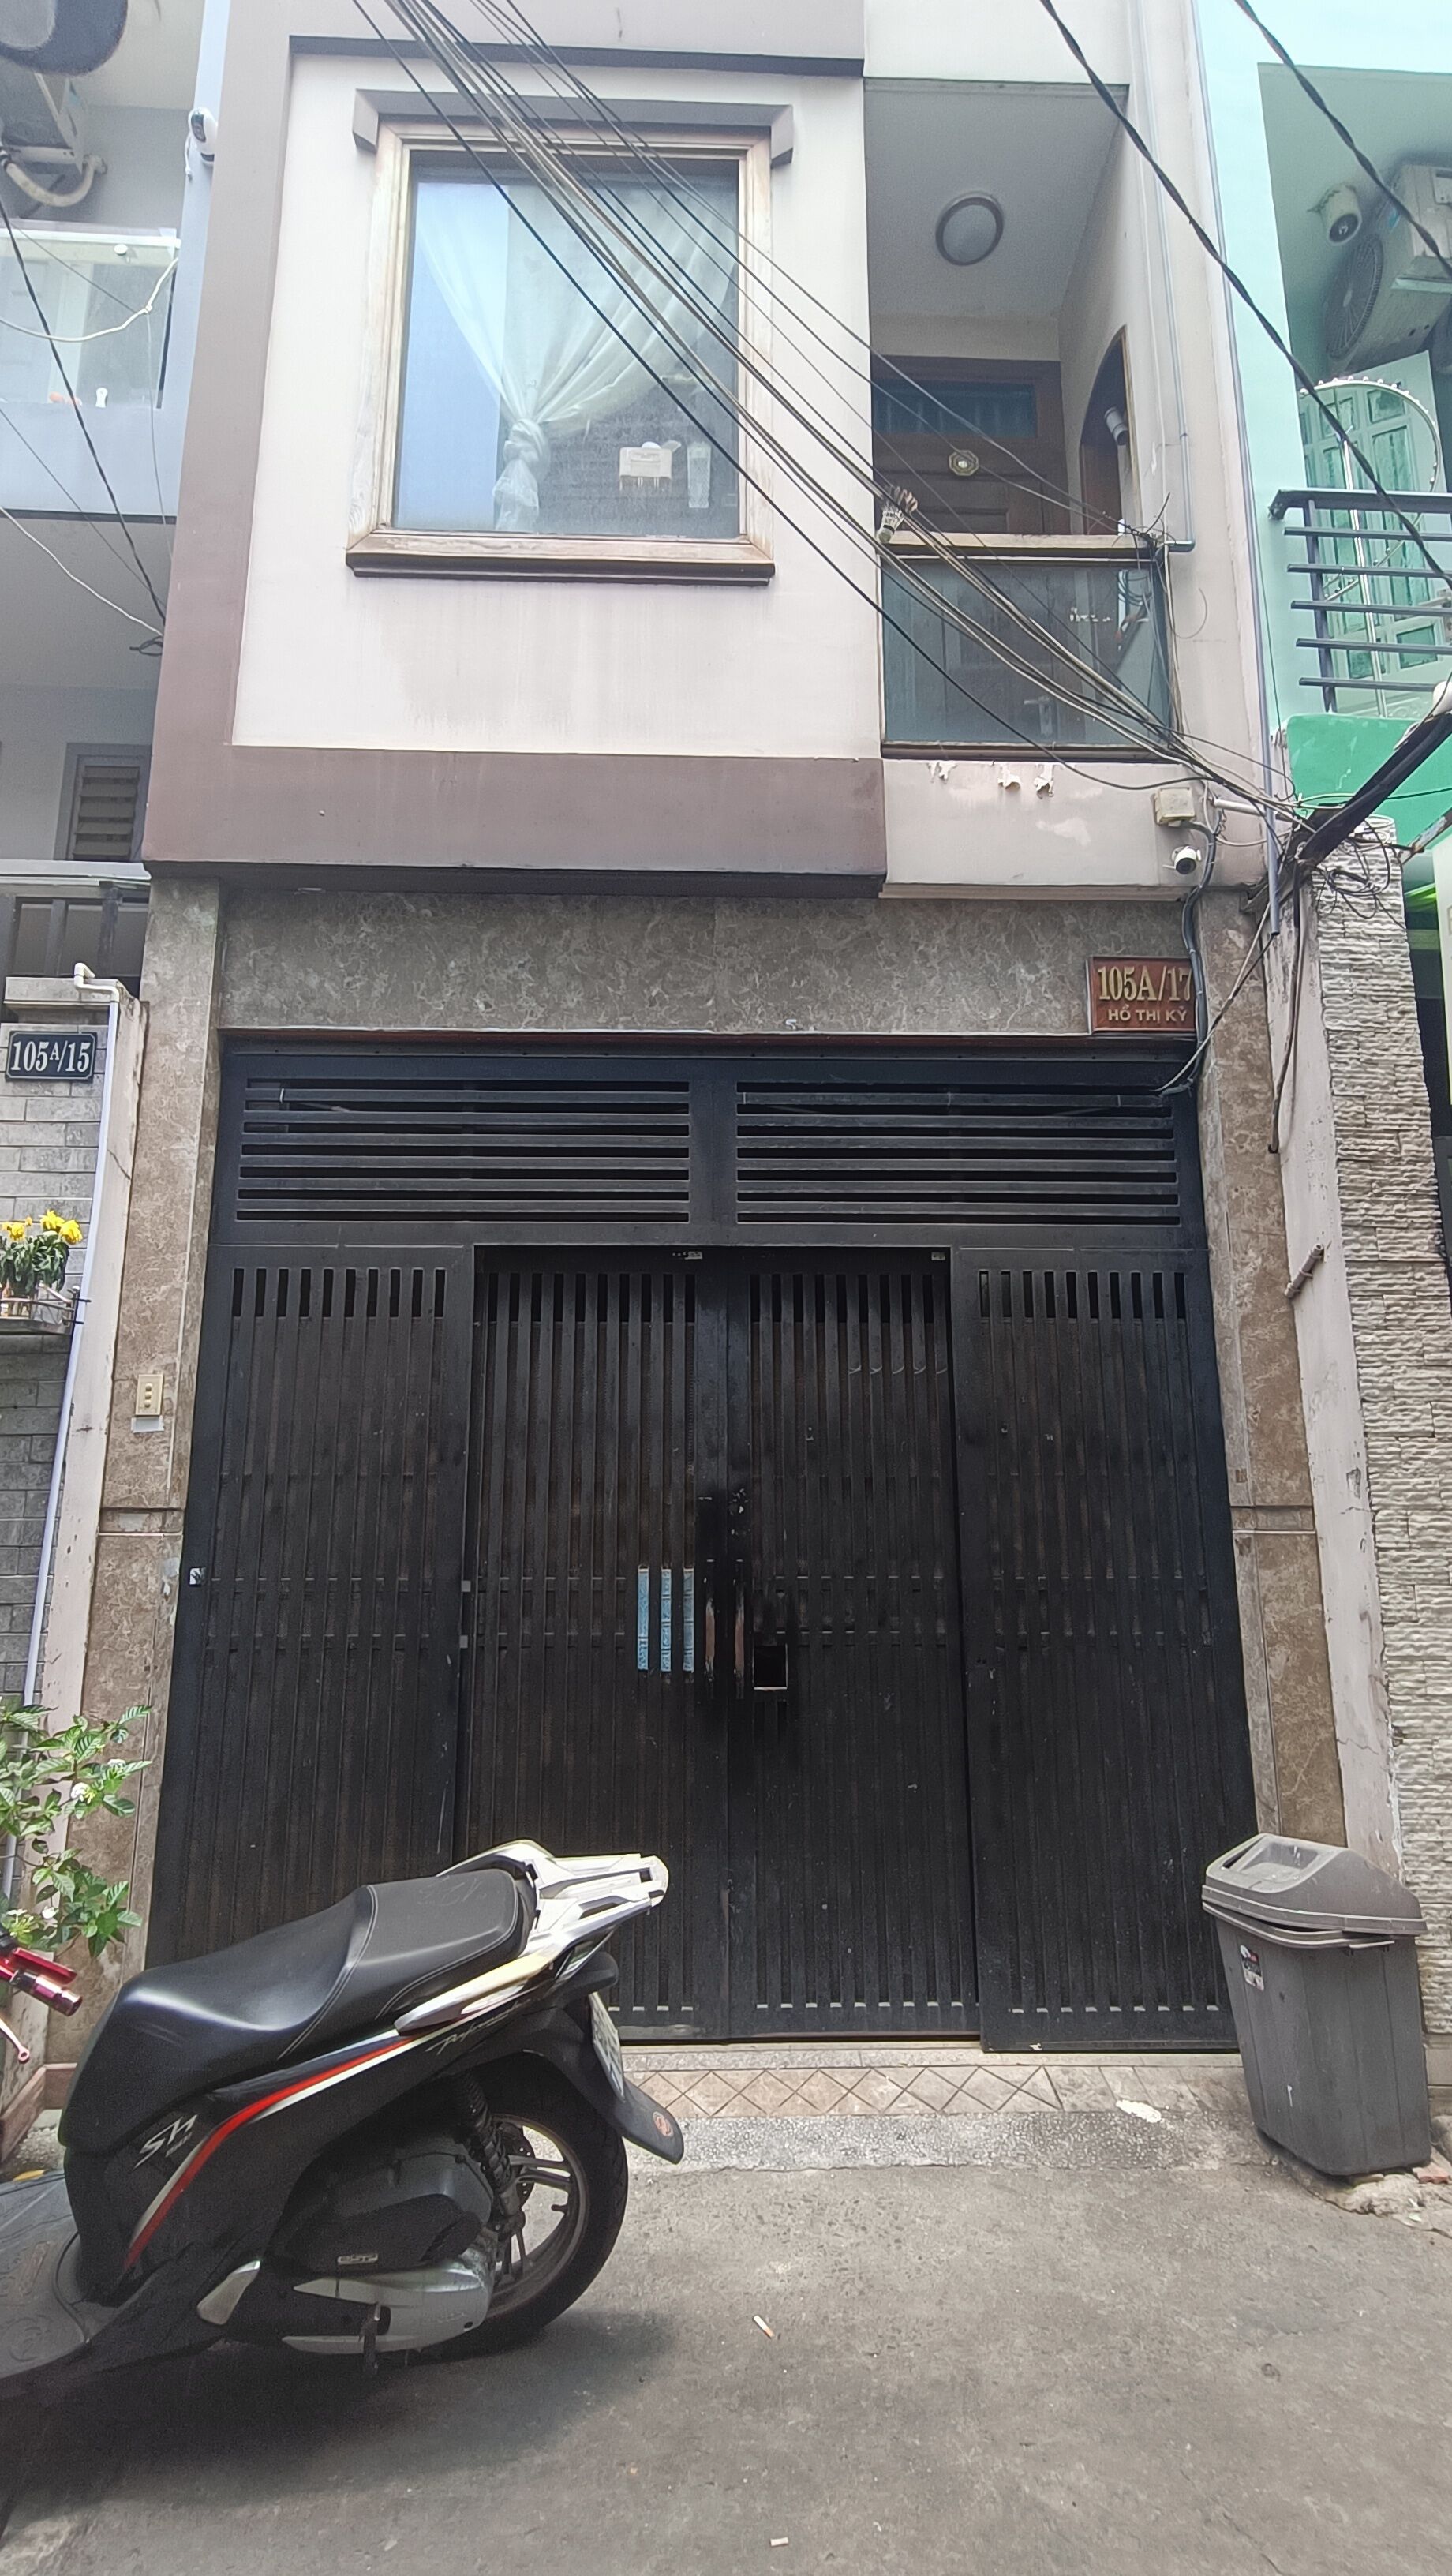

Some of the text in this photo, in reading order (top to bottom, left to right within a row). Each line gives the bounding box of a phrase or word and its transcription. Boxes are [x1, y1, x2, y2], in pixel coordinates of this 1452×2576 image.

[1098, 964, 1192, 1002] 105A/17
[1135, 1009, 1160, 1023] THỊ
[11, 1040, 92, 1073] 105A/15
